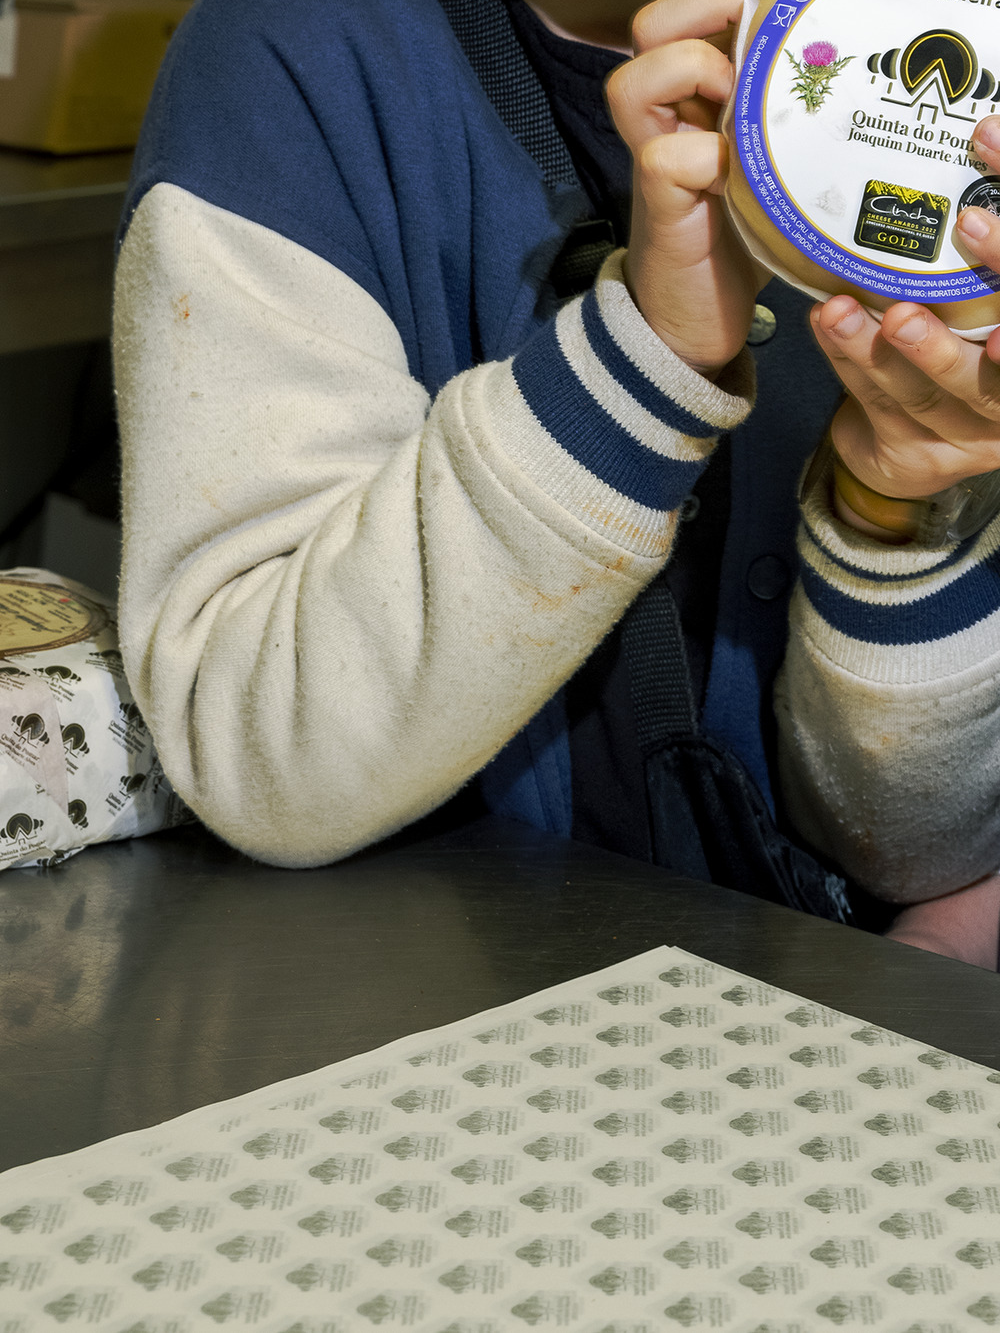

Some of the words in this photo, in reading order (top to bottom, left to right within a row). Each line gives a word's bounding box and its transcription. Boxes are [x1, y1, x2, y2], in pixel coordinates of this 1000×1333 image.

[748, 34, 769, 76] DECLARAÇÃO
[741, 120, 749, 135] POR
[852, 109, 909, 136] Quinta
[913, 124, 935, 142] do
[938, 129, 975, 151] Pom
[846, 127, 902, 152] Joaquim
[905, 141, 952, 163] Duarte
[952, 153, 989, 172] Alves
[870, 195, 939, 225] Cincho
[763, 171, 778, 191] LEITE
[772, 189, 784, 201] DE
[778, 198, 798, 223] OVELHA
[820, 242, 845, 262] COALHO
[849, 261, 898, 283] CONSERVANTE:
[898, 277, 938, 288] NATAMICINA
[938, 279, 951, 288] (NA
[950, 275, 976, 285] CASCA)
[867, 213, 892, 223] CHEESE
[893, 219, 919, 230] AWARDS
[921, 226, 937, 234] 2022
[877, 231, 920, 250] GOLD
[829, 260, 844, 272] DOS
[843, 268, 863, 282] QUAIS
[862, 277, 903, 295] SATURADOS:
[927, 288, 961, 298] HIDRATOS
[961, 286, 972, 295] DE
